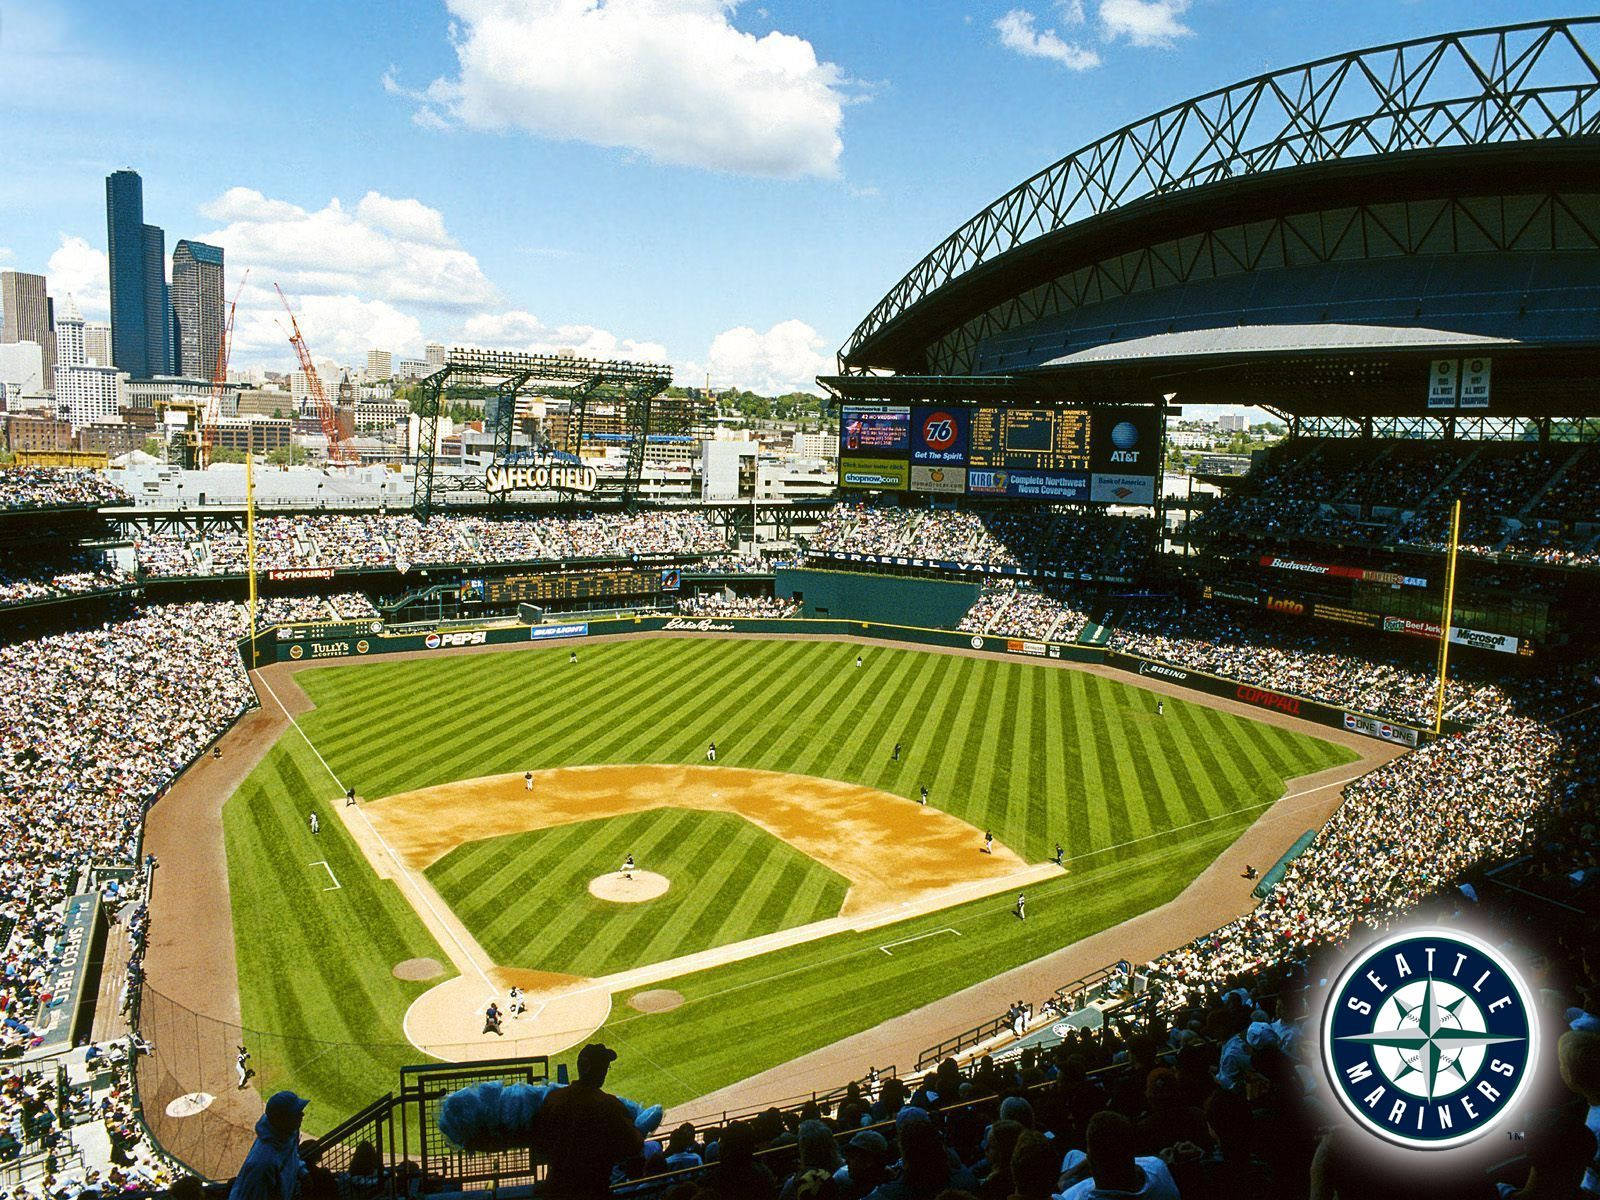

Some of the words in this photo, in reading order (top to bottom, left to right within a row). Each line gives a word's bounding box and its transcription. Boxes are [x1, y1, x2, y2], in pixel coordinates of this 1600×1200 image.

[927, 419, 952, 442] 76
[914, 451, 927, 459] Get
[929, 451, 942, 460] The
[943, 452, 964, 461] Spirit.
[1110, 450, 1140, 463] AT&T
[486, 466, 548, 493] SAFECO
[550, 466, 597, 493] FIELD
[846, 473, 899, 484] shopnow.com
[971, 472, 993, 487] KIRO
[1010, 474, 1044, 486] Complete
[1045, 476, 1087, 488] Northwest
[1018, 485, 1040, 494] News
[1040, 485, 1077, 497] Coverage
[833, 552, 940, 568] GRAEBEL
[957, 562, 1004, 574] VAN
[1016, 567, 1093, 581] LINES
[1270, 558, 1330, 575] Budweiser
[1267, 596, 1304, 614] Lotto
[1405, 620, 1424, 630] Beef
[441, 631, 487, 648] PEPSI
[1456, 628, 1506, 646] Microsoft
[311, 642, 349, 654] TULLY'S
[1151, 665, 1188, 680] BOEING
[1236, 685, 1301, 715] COMPAQ
[1356, 718, 1376, 732] ONE
[1393, 729, 1414, 742] ONE
[60, 926, 85, 968] SAFECO
